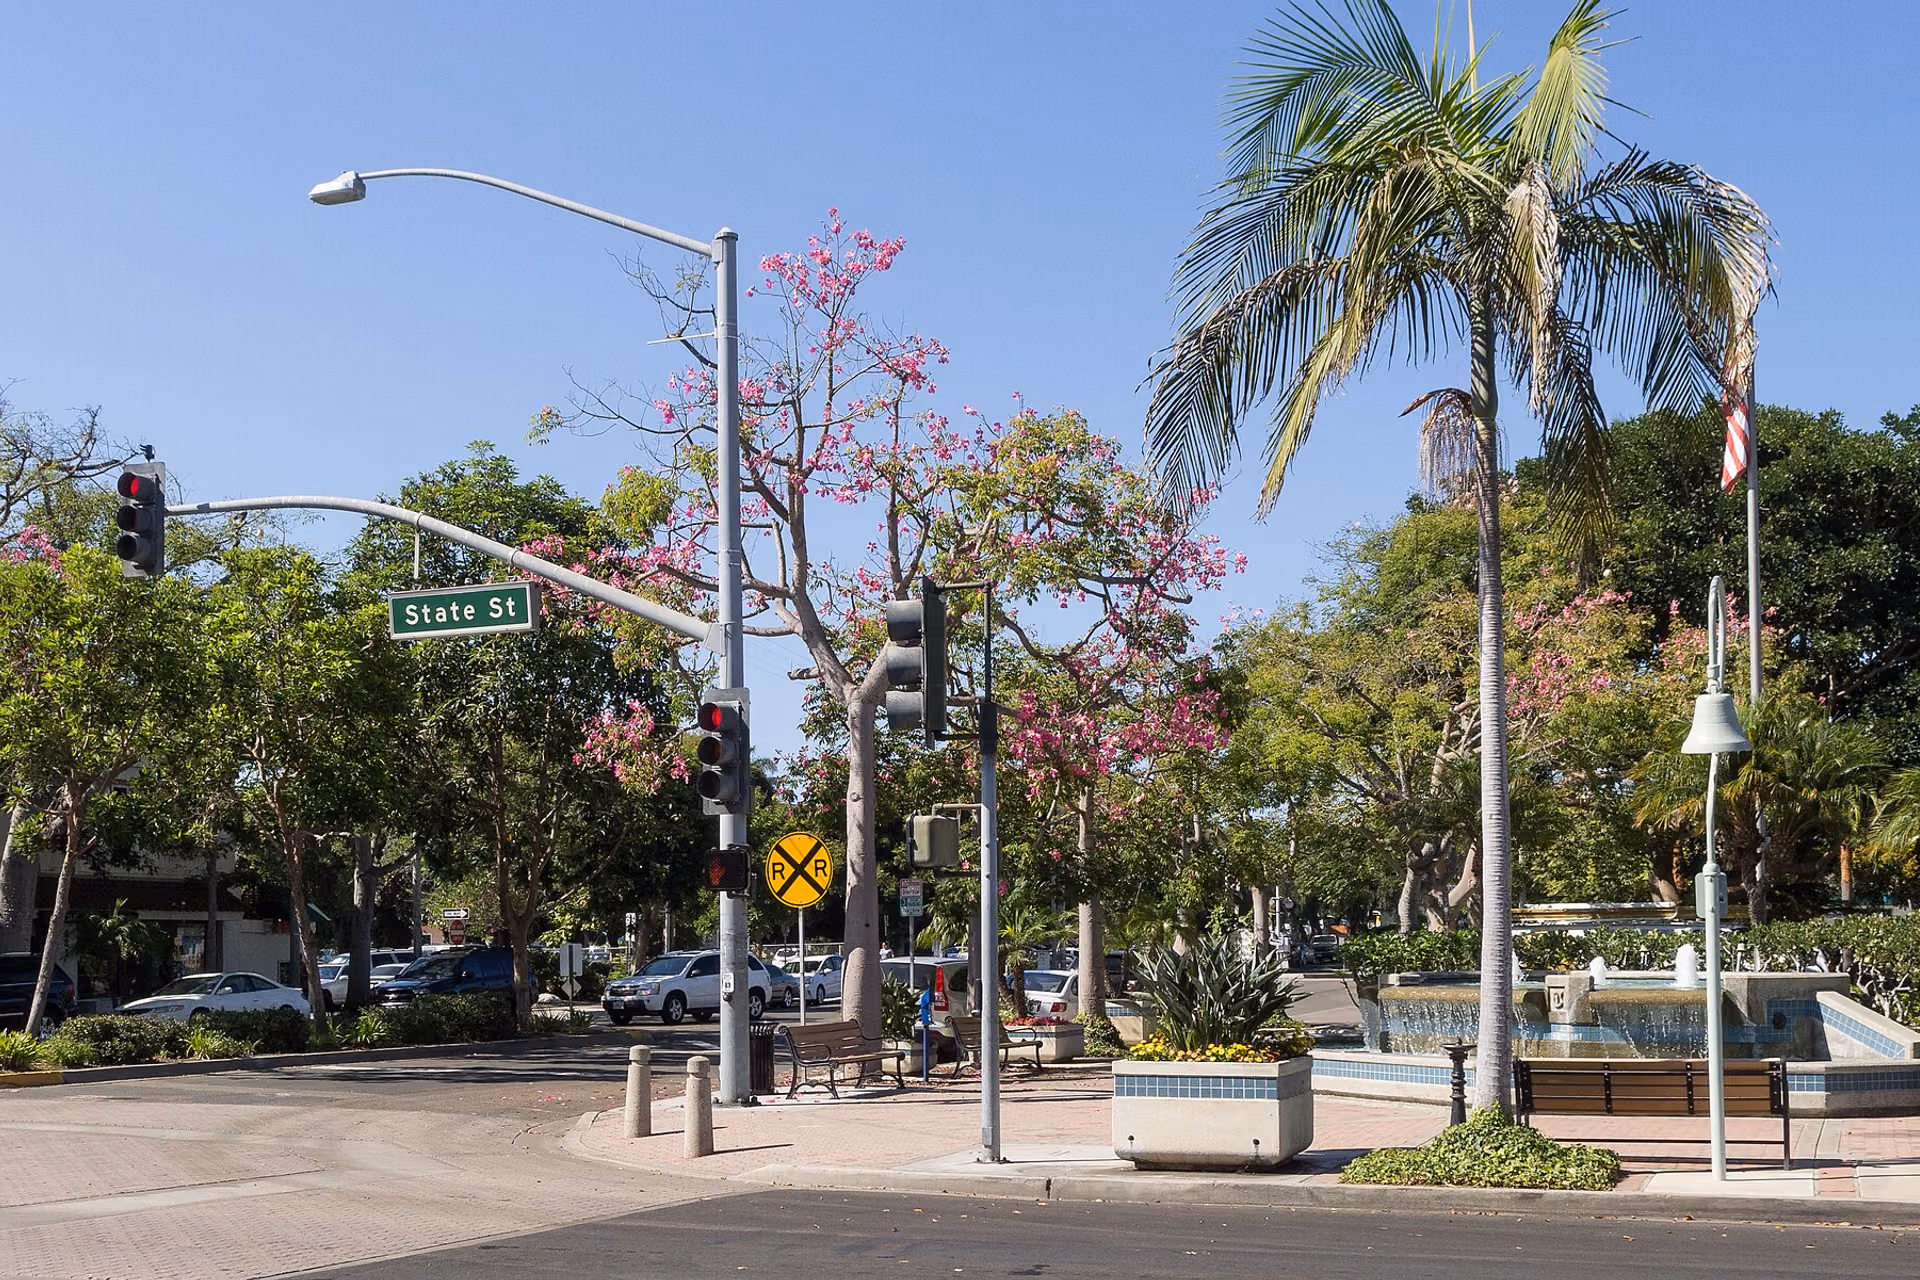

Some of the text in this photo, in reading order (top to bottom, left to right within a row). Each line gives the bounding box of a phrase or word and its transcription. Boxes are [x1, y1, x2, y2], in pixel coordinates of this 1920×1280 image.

[405, 596, 516, 625] State St
[772, 859, 827, 880] R R
